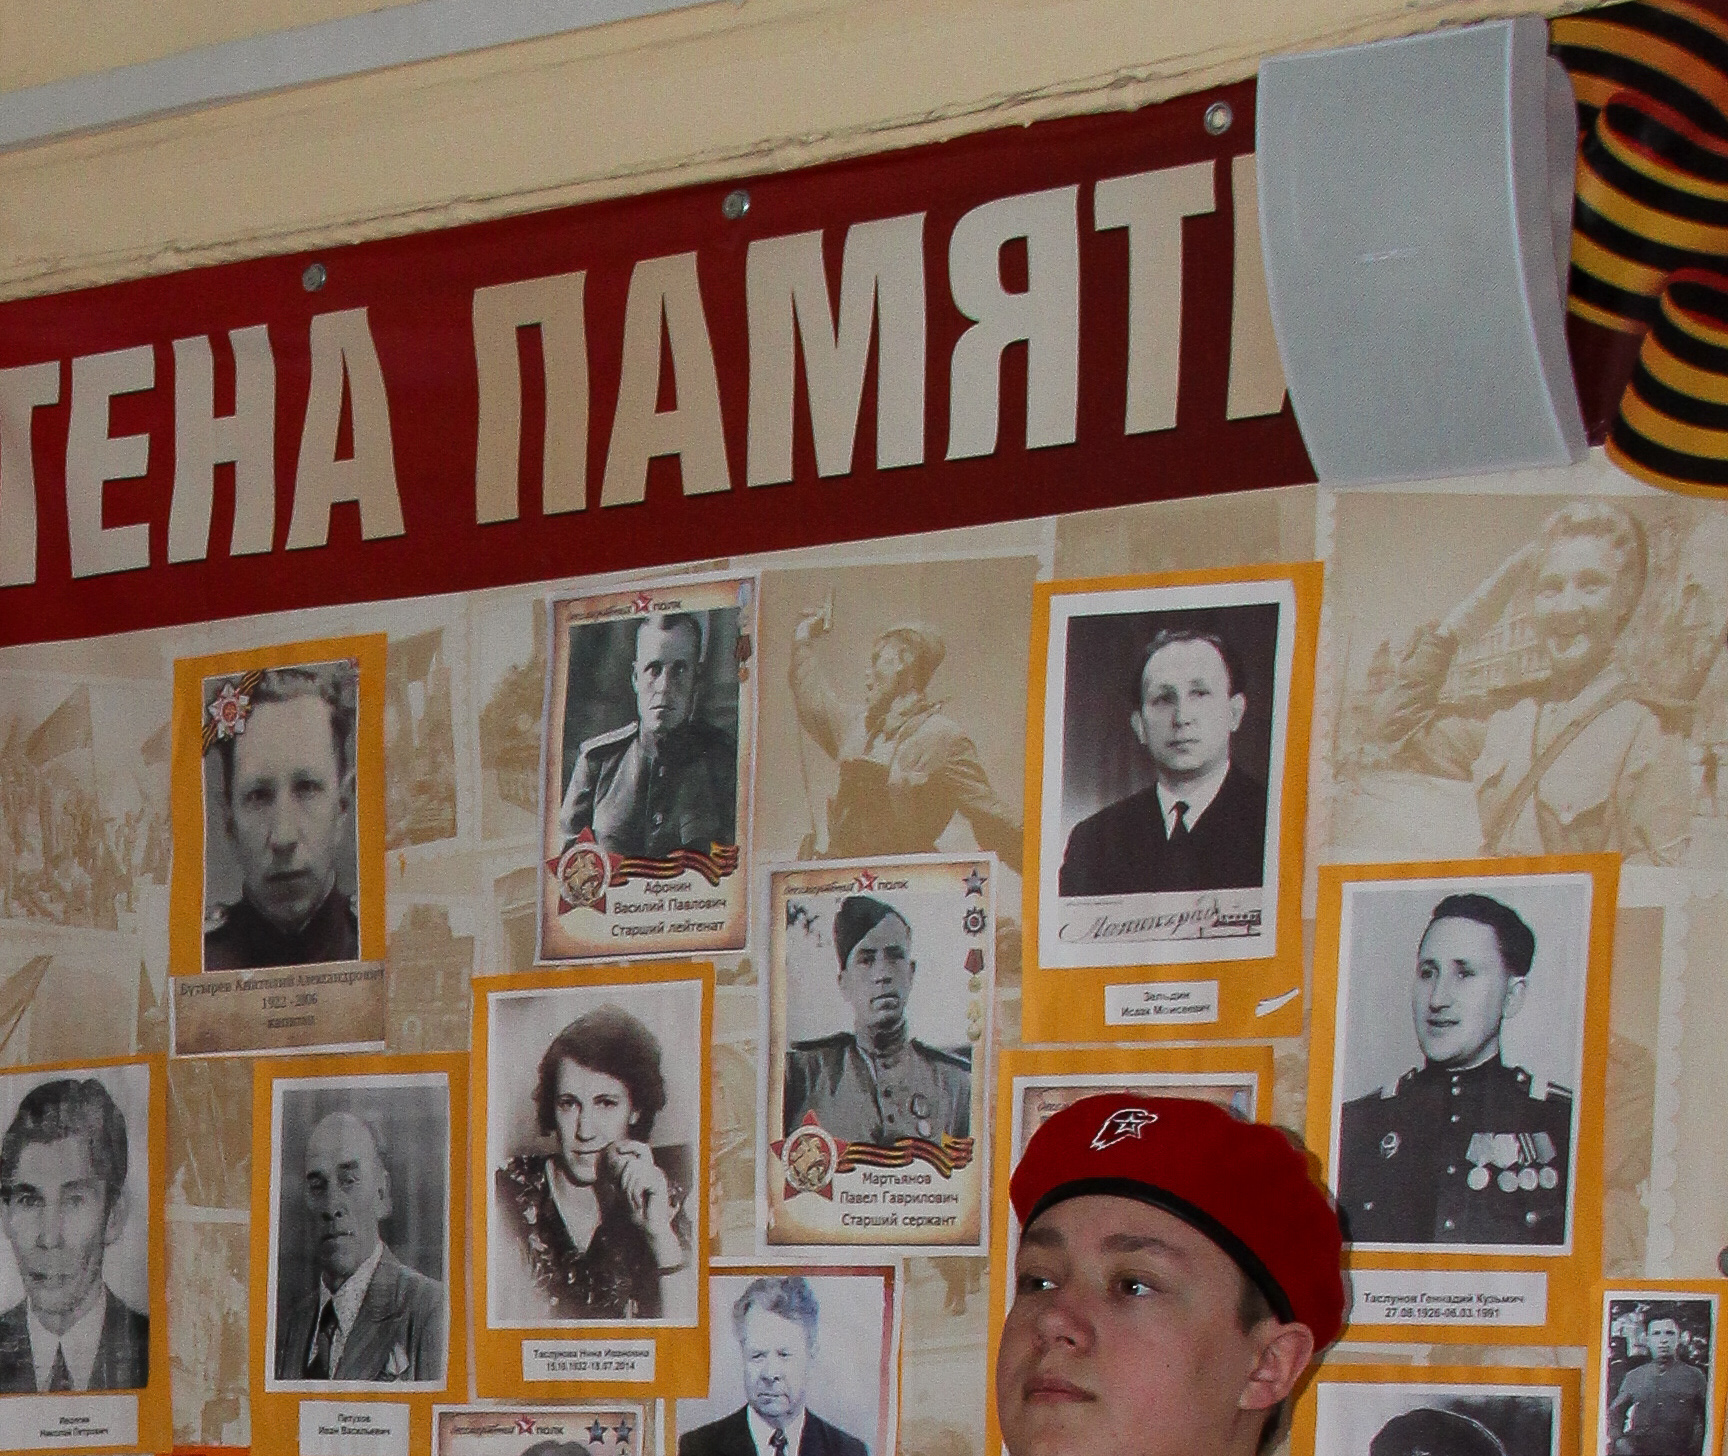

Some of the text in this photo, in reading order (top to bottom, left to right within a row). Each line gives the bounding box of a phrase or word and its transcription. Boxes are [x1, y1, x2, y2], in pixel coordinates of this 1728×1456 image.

[643, 881, 691, 895] Афонин
[614, 898, 726, 914] Василий Павлович
[611, 923, 664, 937] Старший
[862, 1172, 932, 1188] Мартьянов
[840, 1191, 959, 1206] Павел Гаврилович
[842, 1213, 956, 1228] Старший сержант
